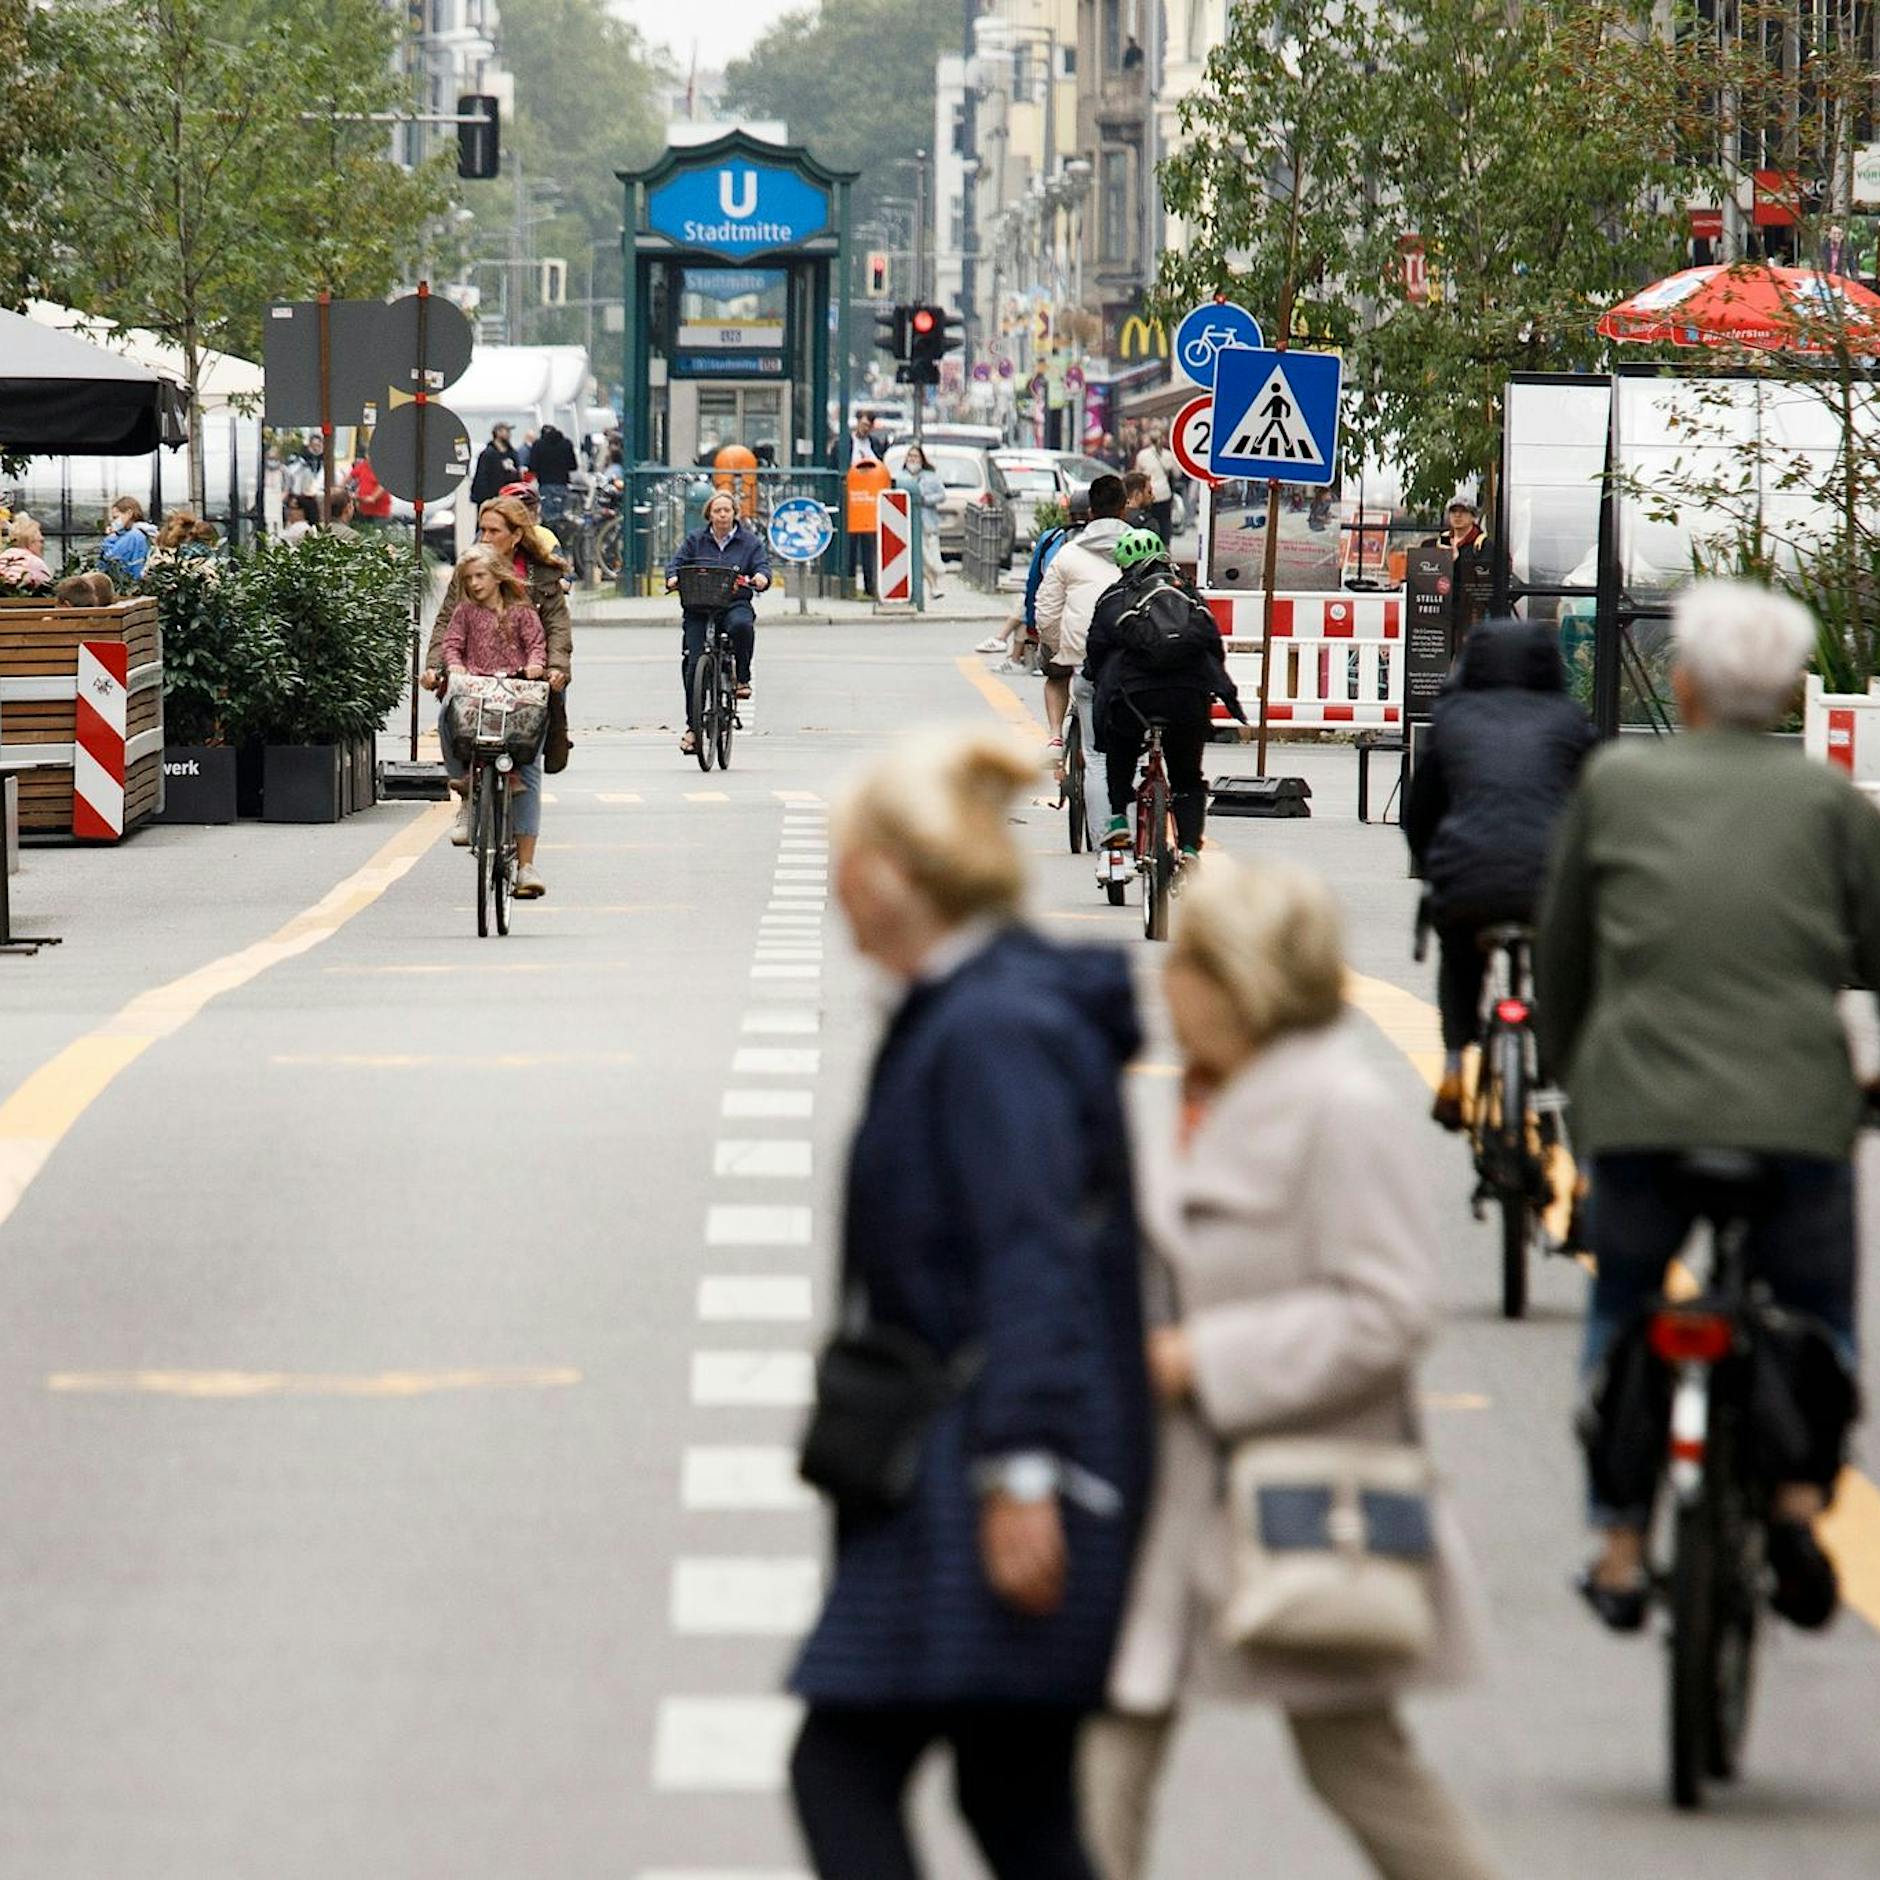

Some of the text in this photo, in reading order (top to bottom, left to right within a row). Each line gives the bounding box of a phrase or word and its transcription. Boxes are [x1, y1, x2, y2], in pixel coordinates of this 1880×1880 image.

[719, 171, 758, 218] U
[684, 220, 792, 242] Stadtmitte
[1193, 421, 1211, 454] 2
[1416, 594, 1443, 603] STELLE
